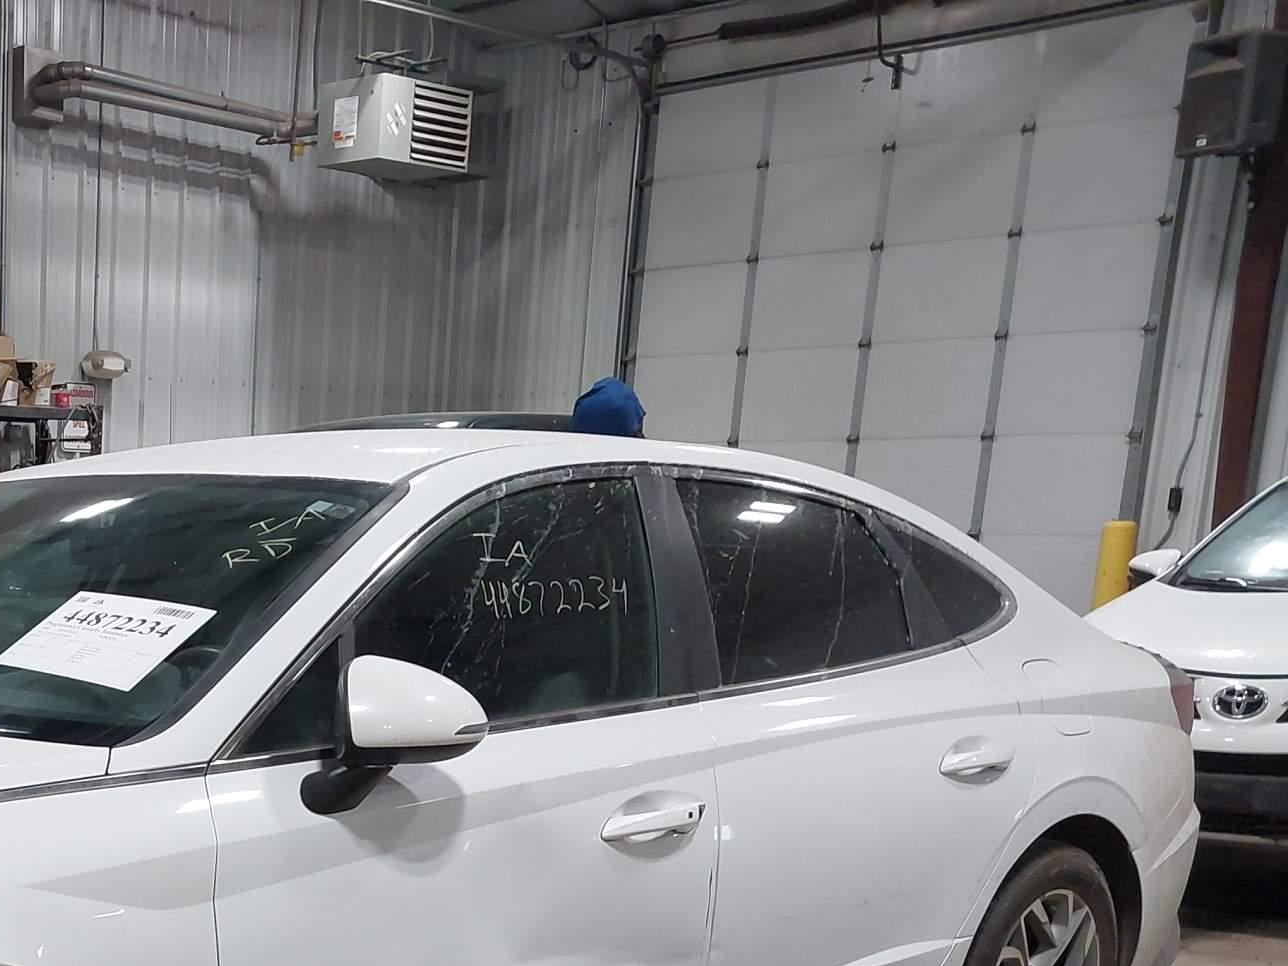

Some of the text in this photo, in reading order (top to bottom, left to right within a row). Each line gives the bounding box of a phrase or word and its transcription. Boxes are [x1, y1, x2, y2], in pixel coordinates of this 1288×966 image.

[473, 533, 532, 567] IA
[481, 577, 628, 618] 44872234
[63, 609, 176, 638] 44872234
